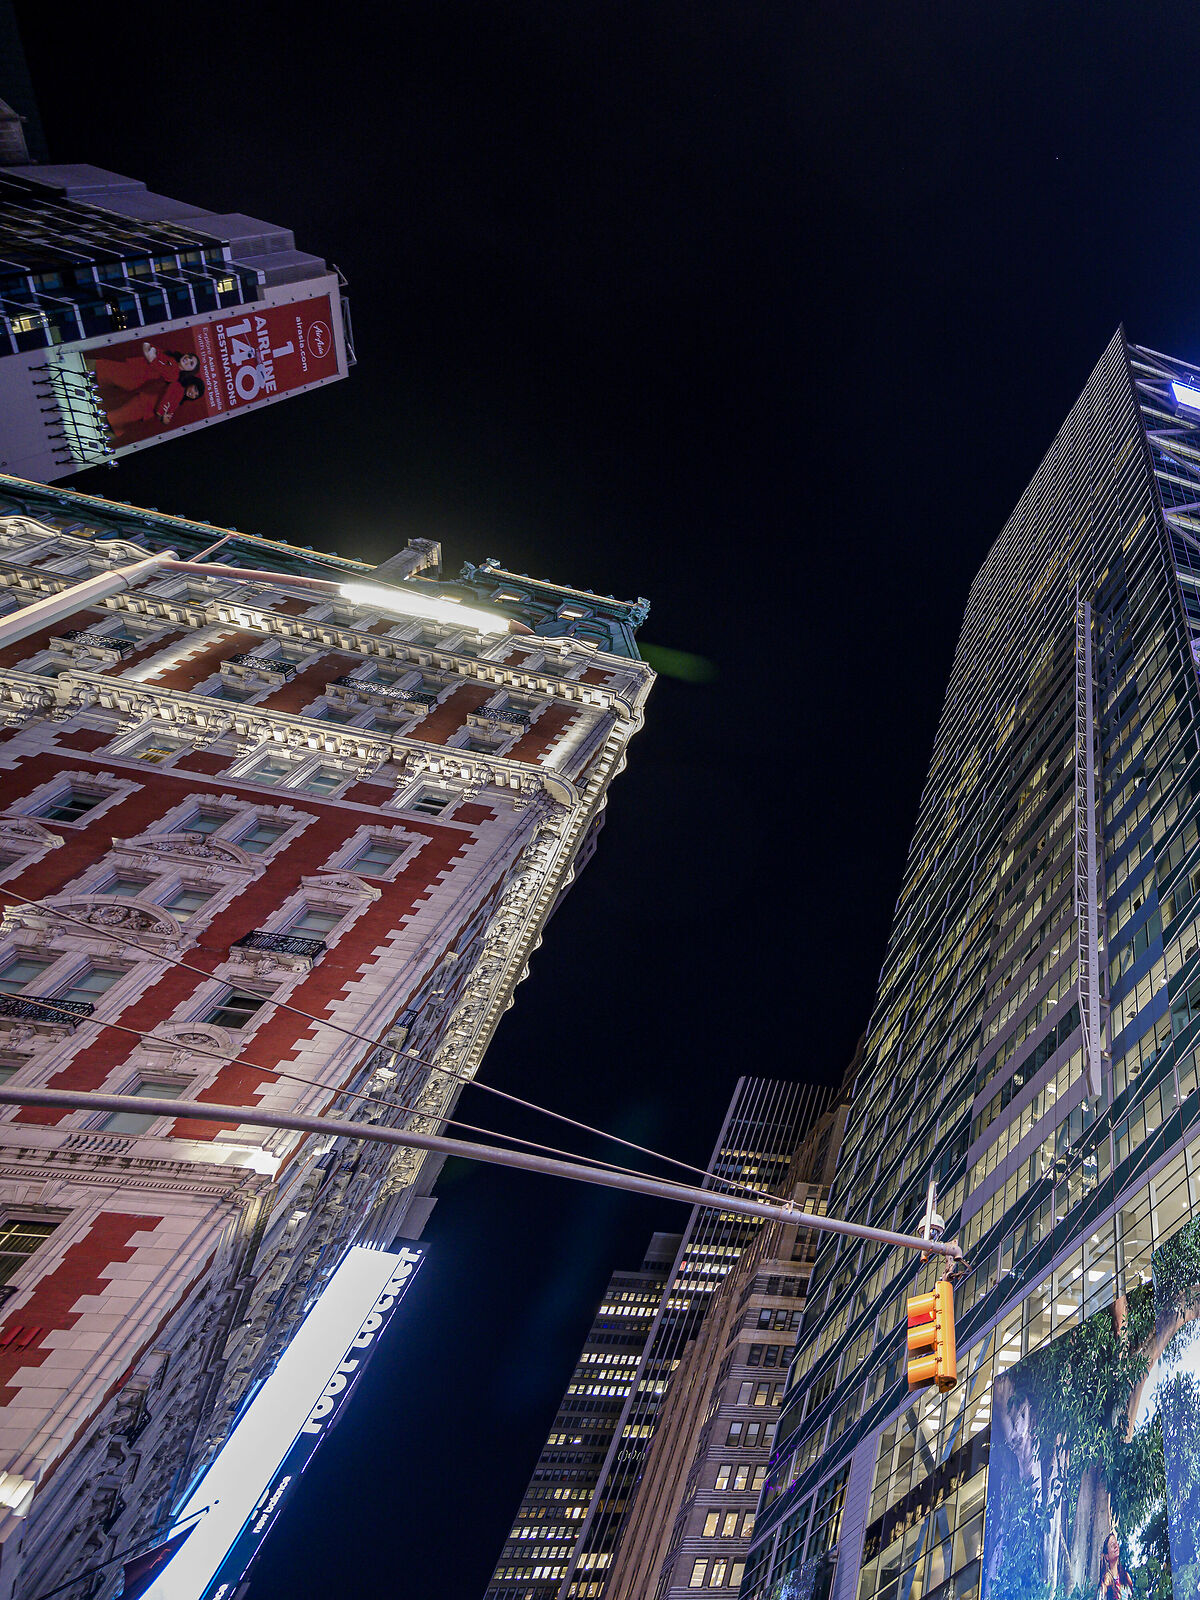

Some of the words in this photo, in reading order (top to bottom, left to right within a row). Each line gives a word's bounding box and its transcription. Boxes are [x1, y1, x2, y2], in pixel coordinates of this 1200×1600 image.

[216, 324, 237, 406] DESTINATIONS
[225, 318, 261, 401] 140
[254, 316, 277, 394] AIRLINE
[272, 340, 295, 359] 1
[295, 316, 308, 372] airasia.com
[252, 1513, 269, 1534] new
[262, 1476, 292, 1514] balance
